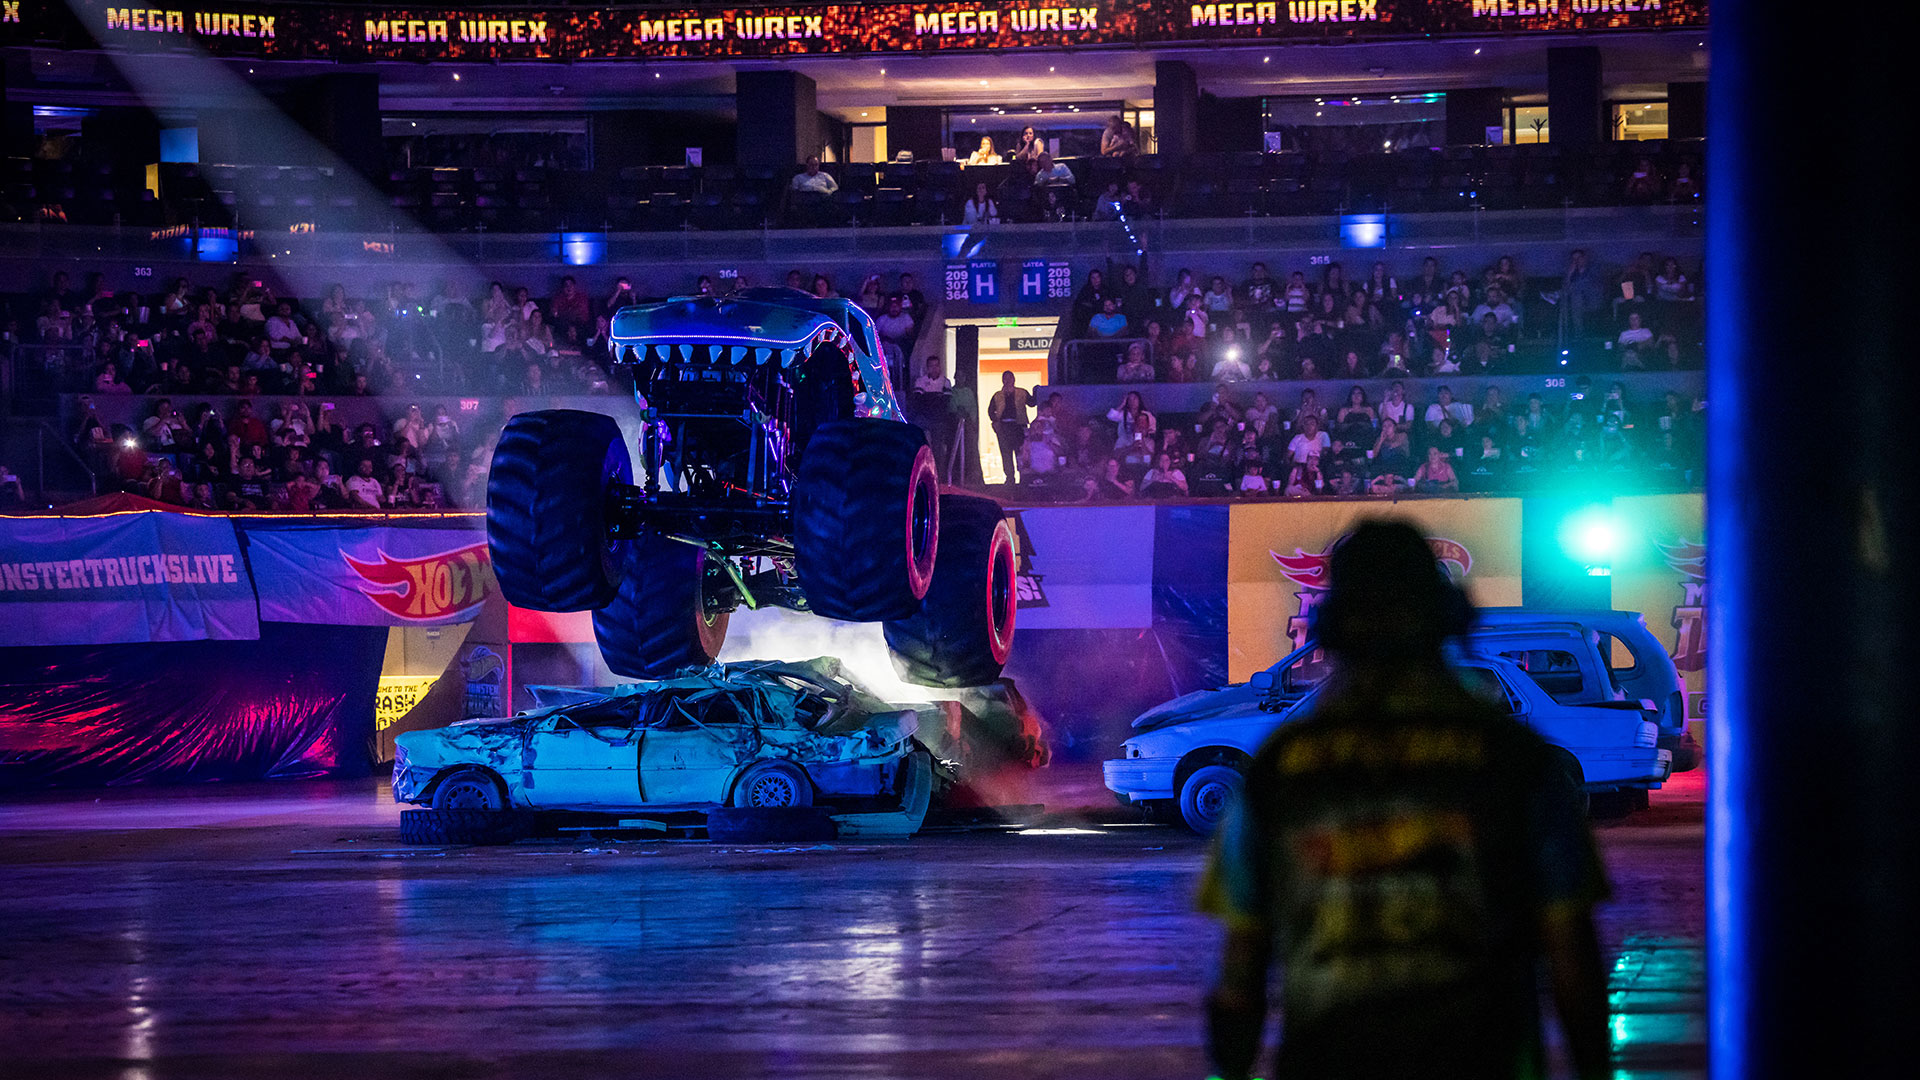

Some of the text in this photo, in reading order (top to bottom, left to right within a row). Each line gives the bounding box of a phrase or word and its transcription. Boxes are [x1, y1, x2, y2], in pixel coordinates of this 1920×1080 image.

[1191, 0, 1377, 26] MEGA WREX
[106, 8, 276, 38] MEGA WREX
[640, 16, 822, 42] MEGA WREX
[915, 8, 1097, 35] MEGA WREX
[365, 20, 547, 43] MEGA WREX
[135, 267, 152, 276] 363
[945, 270, 969, 280] 209
[1048, 267, 1071, 278] 209
[946, 280, 968, 290] 307
[976, 273, 994, 296] H
[1023, 273, 1041, 295] H
[1048, 277, 1071, 288] 308
[946, 290, 969, 300] 364
[1048, 288, 1071, 298] 365
[1545, 378, 1566, 388] 308
[460, 400, 479, 410] 307
[0, 554, 238, 591] NSTERTRUCKSLIVE
[402, 560, 466, 617] HOT
